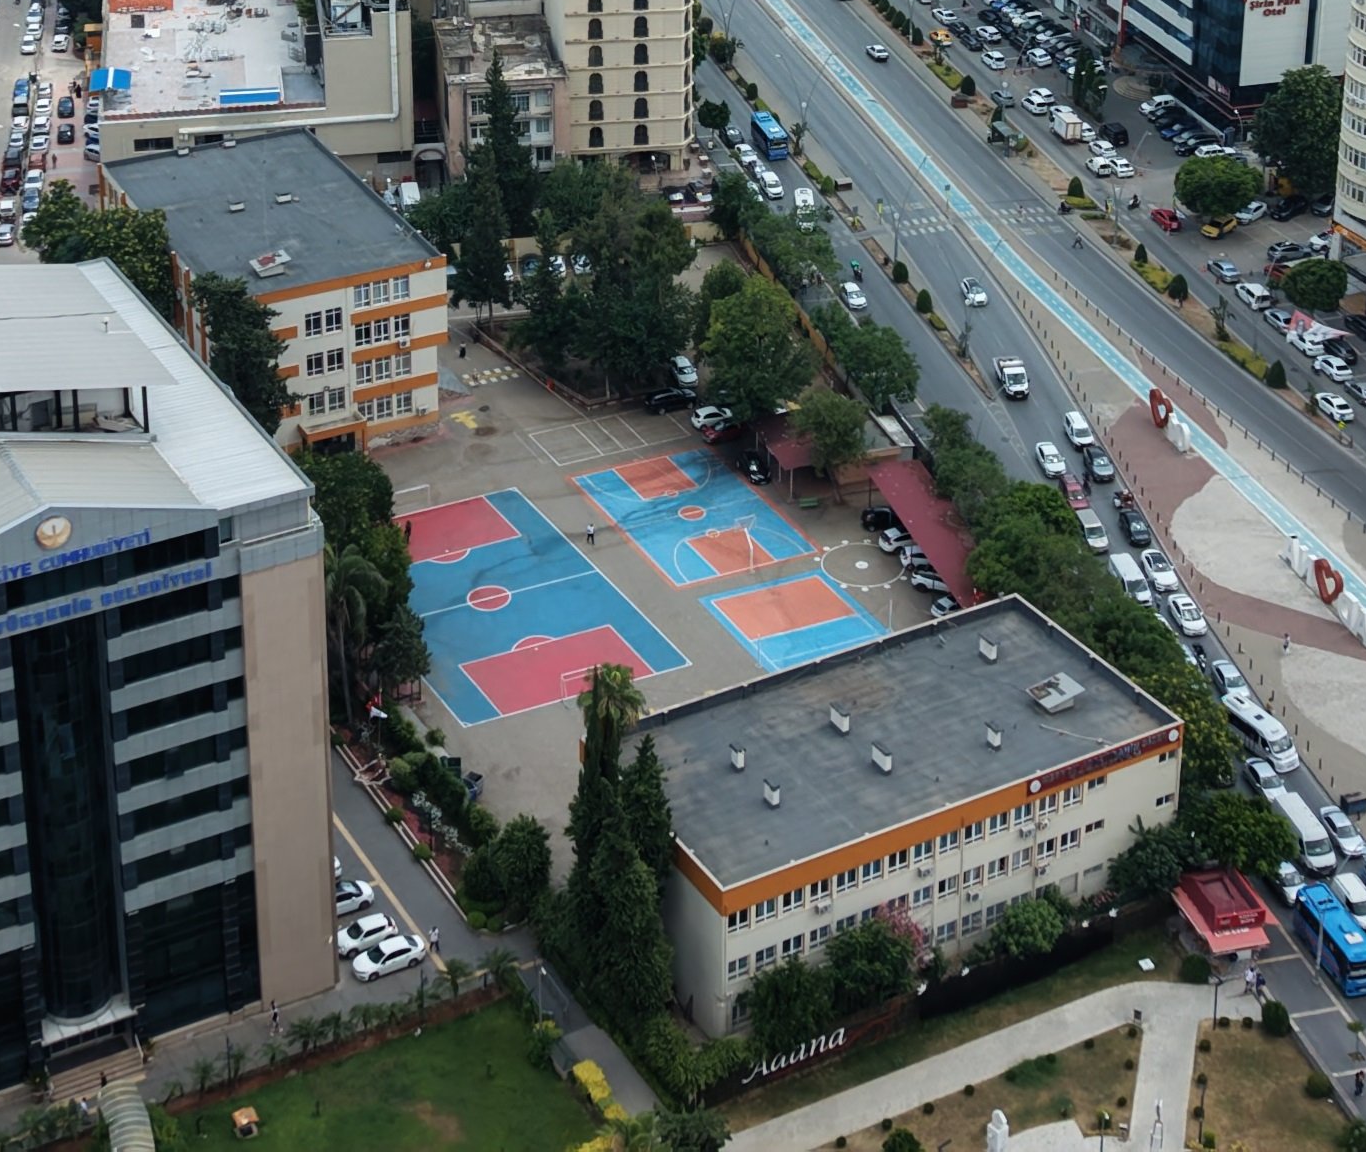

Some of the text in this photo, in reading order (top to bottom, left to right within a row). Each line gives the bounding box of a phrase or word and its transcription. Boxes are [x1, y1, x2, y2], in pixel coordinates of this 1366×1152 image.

[1250, 0, 1275, 11] Şirin
[1263, 6, 1286, 17] Otel
[38, 528, 151, 572] CUMHURİYETİ
[100, 561, 212, 607] BELEDİYESİ
